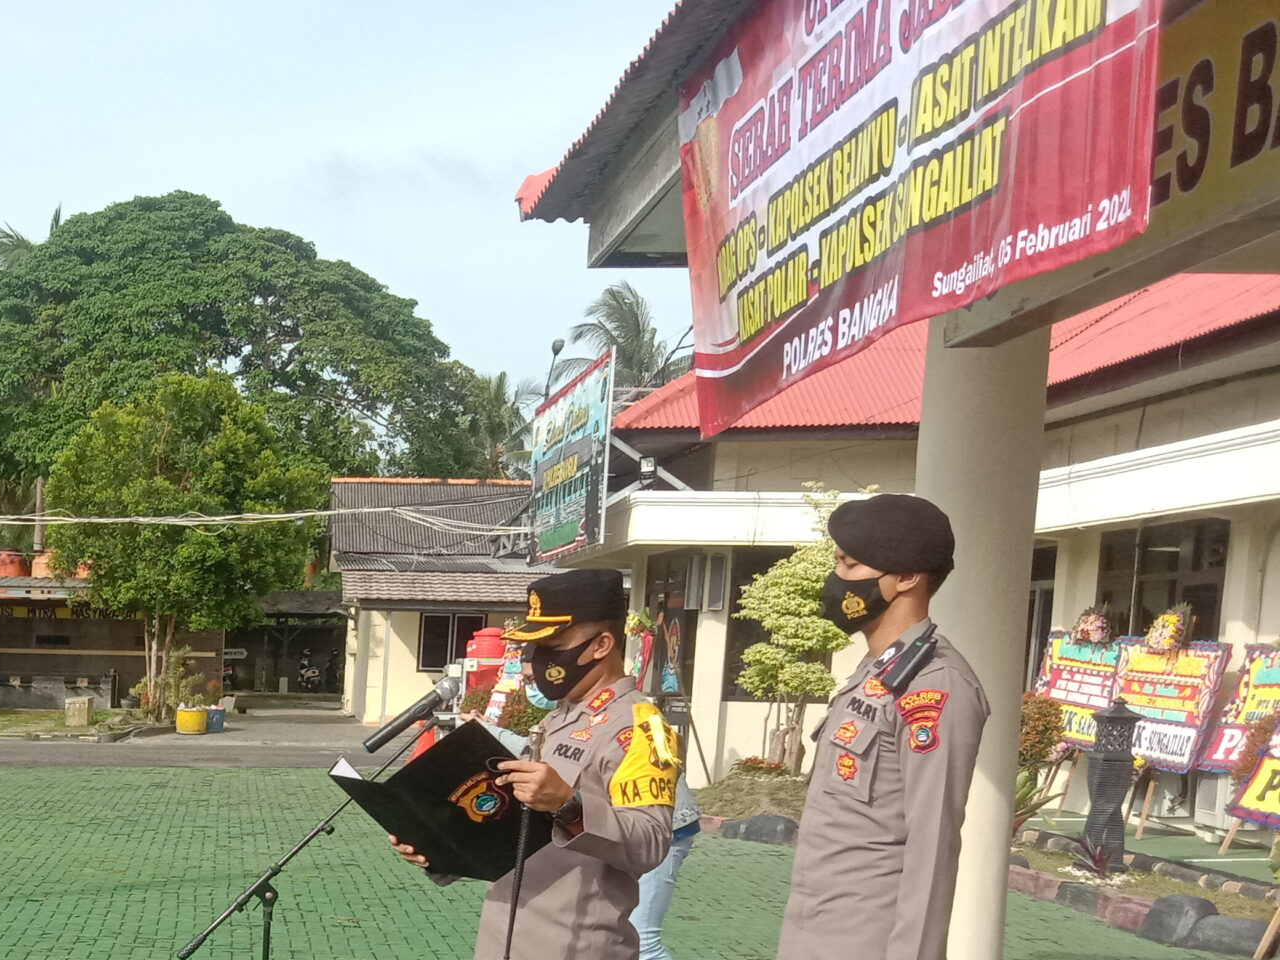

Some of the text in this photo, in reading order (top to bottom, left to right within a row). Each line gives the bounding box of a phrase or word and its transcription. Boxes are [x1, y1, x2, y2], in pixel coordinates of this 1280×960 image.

[730, 75, 792, 200] SERAH
[798, 0, 892, 142] TERIMA
[737, 217, 757, 276] OPS
[768, 157, 831, 250] KAPOLSEK
[832, 106, 896, 205] BELINYU
[766, 251, 808, 323] POLAIR
[820, 191, 893, 290] KAPOLSEK
[893, 116, 1007, 244] SUNGAILIAT
[997, 235, 1013, 268] 05
[1014, 203, 1093, 260] Februari
[782, 274, 900, 379] POLRES BANGKA
[26, 607, 57, 619] MITRA
[70, 607, 138, 620] MASYARAAT
[846, 696, 878, 722] POLRI
[552, 743, 585, 762] POLRI
[619, 776, 674, 805] KA OPS
